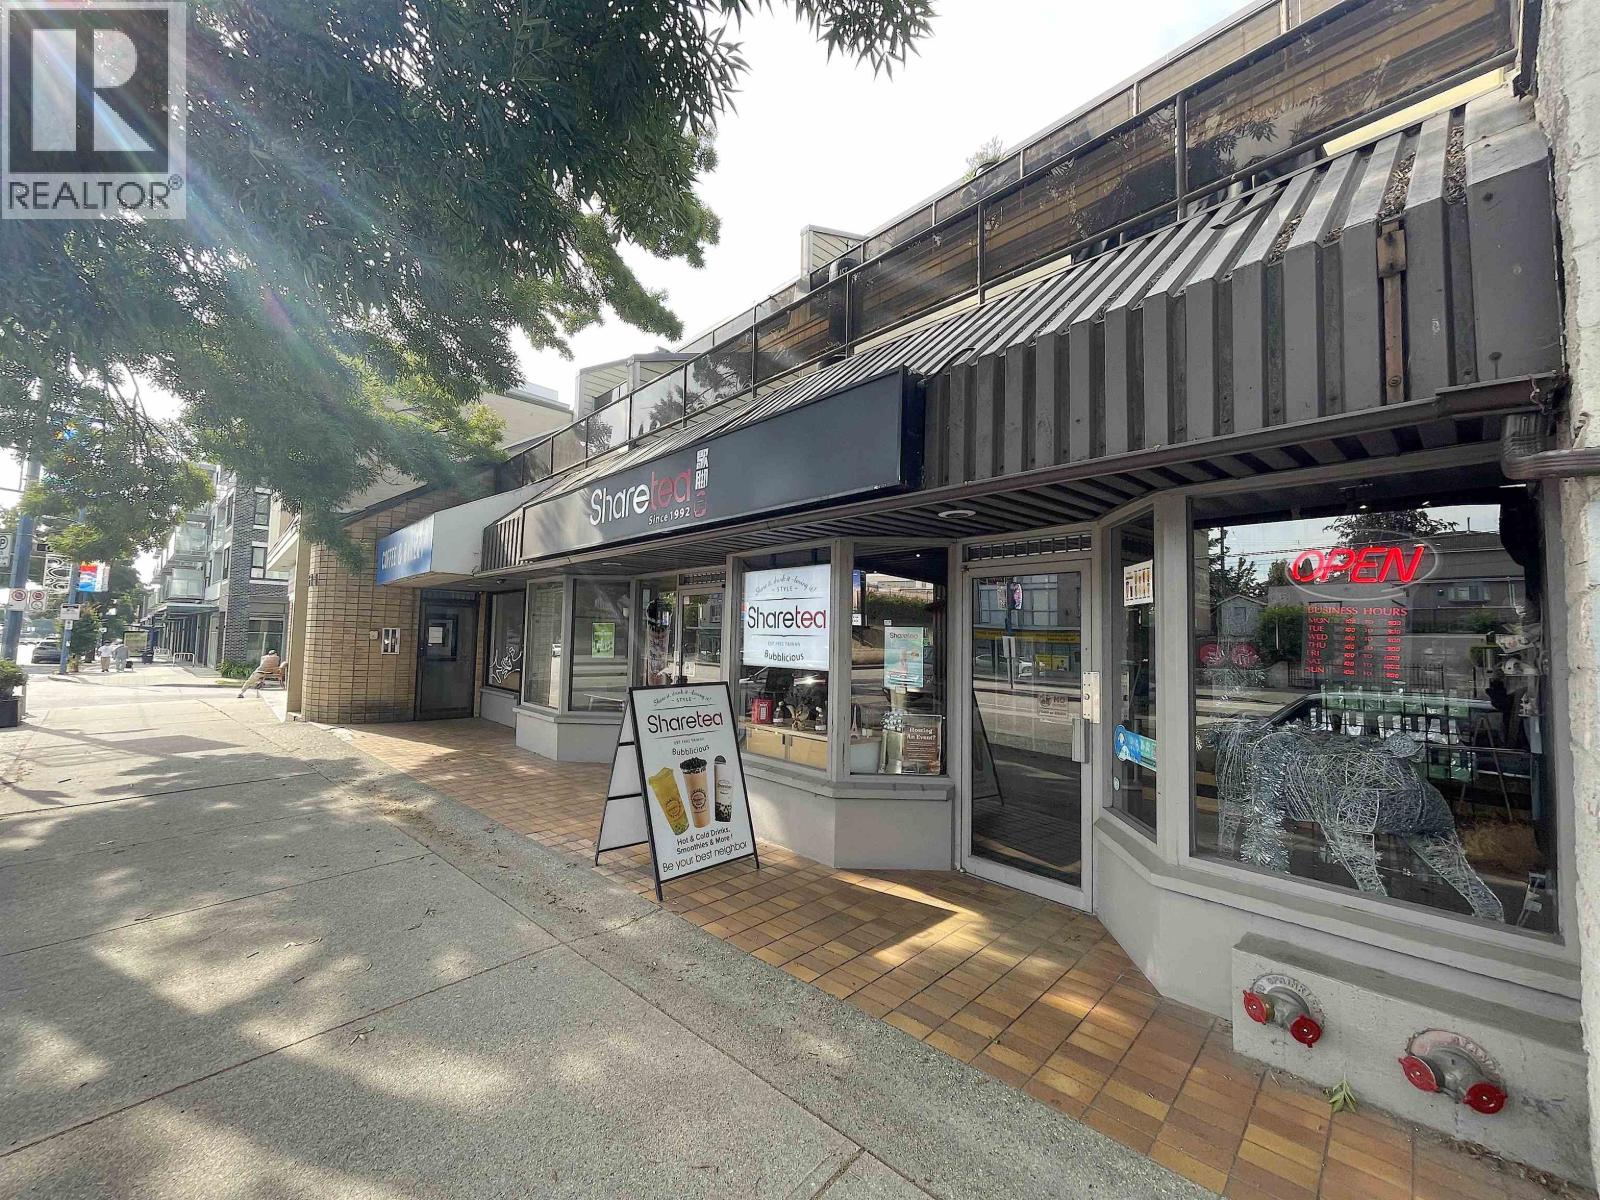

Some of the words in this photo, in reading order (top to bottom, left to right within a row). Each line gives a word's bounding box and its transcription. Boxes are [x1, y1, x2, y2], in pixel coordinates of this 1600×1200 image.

[589, 467, 692, 526] Sharetea
[1291, 545, 1425, 583] OPEN
[747, 605, 827, 629] Sharetea
[1307, 606, 1359, 616] BUSINESS
[1362, 607, 1408, 616] HOURS
[1308, 641, 1327, 649] THU
[764, 649, 804, 662] Bubblicious
[647, 711, 724, 734] Sharetea
[672, 744, 710, 756] Bubblicious
[677, 837, 689, 846] Hot
[689, 834, 695, 842] &
[695, 831, 710, 841] Cold
[676, 840, 709, 855] Smoothies
[662, 862, 674, 873] Be
[675, 856, 694, 870] your
[695, 849, 713, 862] best
[714, 841, 747, 856] neighbor
